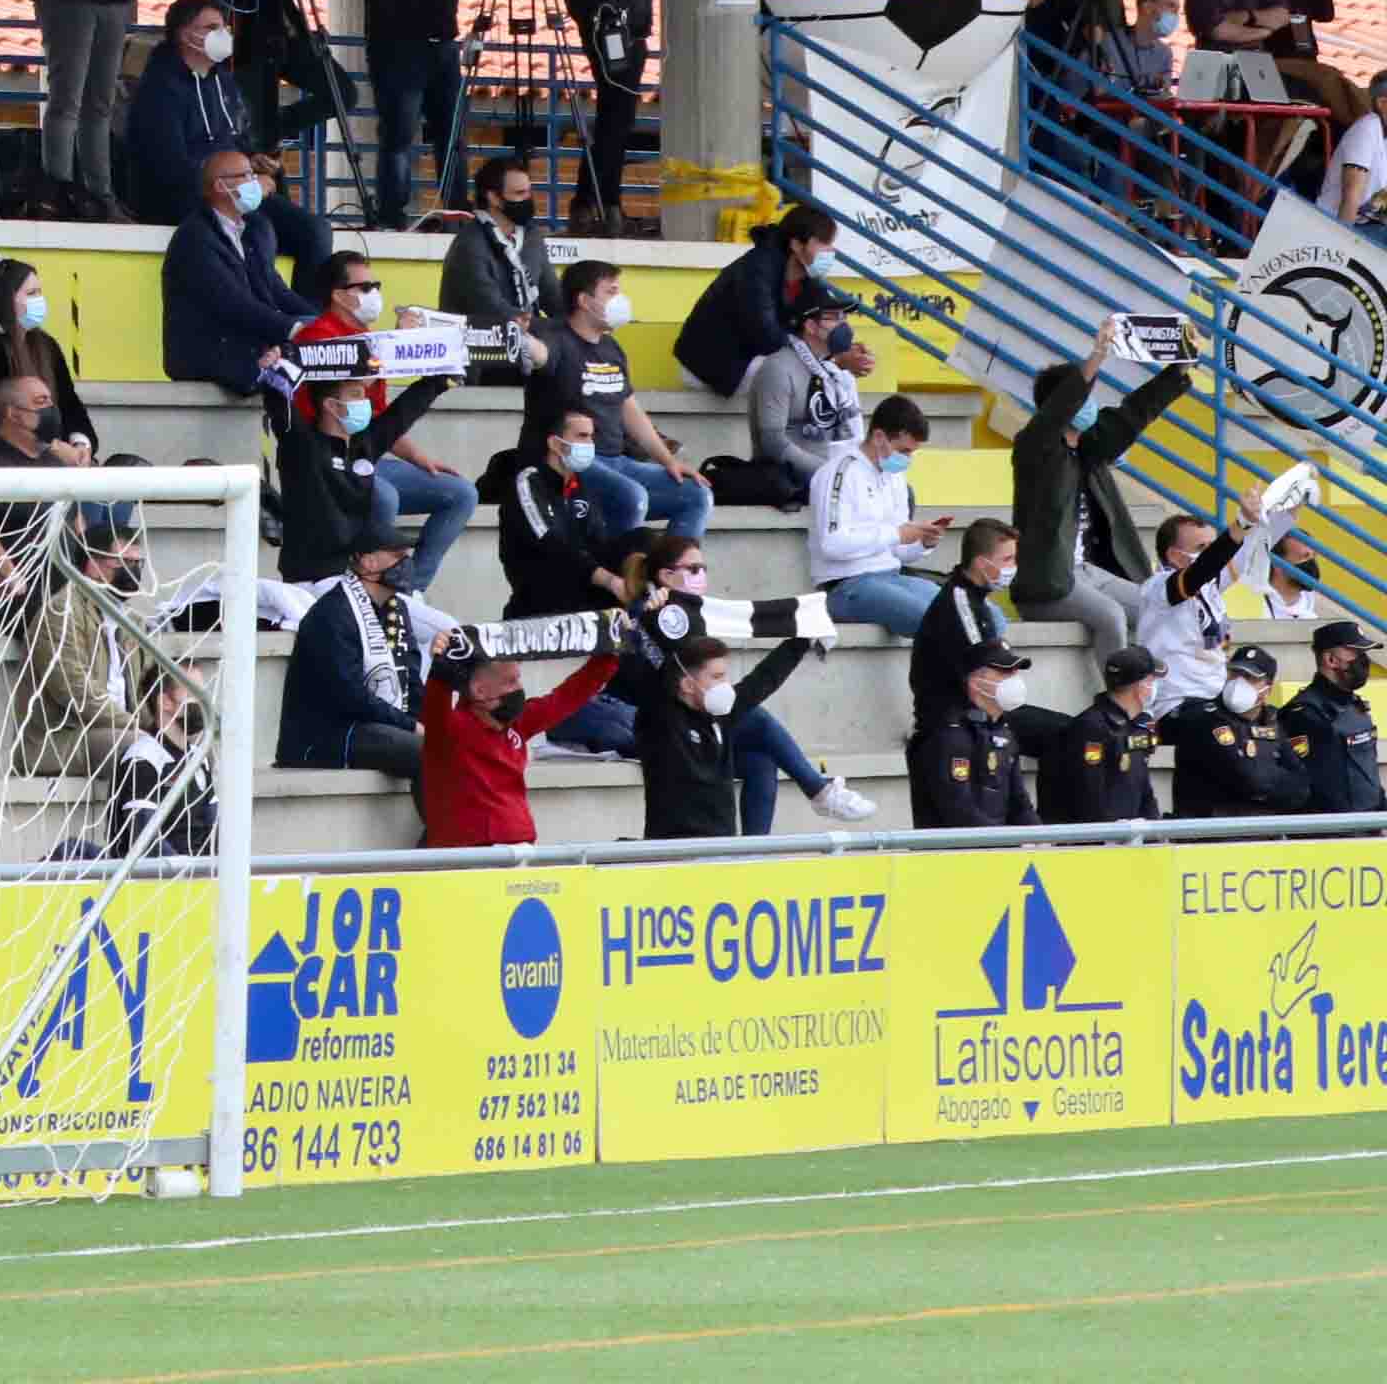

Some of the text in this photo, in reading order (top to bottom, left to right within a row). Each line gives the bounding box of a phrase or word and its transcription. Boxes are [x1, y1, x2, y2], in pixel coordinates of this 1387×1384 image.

[394, 342, 448, 362] MADRID
[1181, 866, 1387, 915] ELECTRICID
[296, 886, 402, 955] JOR
[600, 894, 886, 987] Hnos GOMEZ
[291, 951, 399, 1020] CAR
[504, 953, 560, 989] avanti
[300, 1028, 396, 1063] reformas
[602, 1022, 697, 1063] Materiales
[701, 1020, 723, 1057] de
[935, 1019, 1124, 1086] Lafisconta
[1180, 998, 1294, 1101] Santa
[486, 1050, 576, 1081] 923 211 34
[245, 1074, 412, 1114] ADIO NAVEIRA
[478, 1090, 581, 1121] 677 562 142
[674, 1069, 819, 1105] ALBA DE TORMES
[936, 1093, 1012, 1128] Abogado
[292, 1123, 341, 1171] 144
[351, 1119, 401, 1167] 793
[474, 1131, 582, 1162] 686 14 81 06
